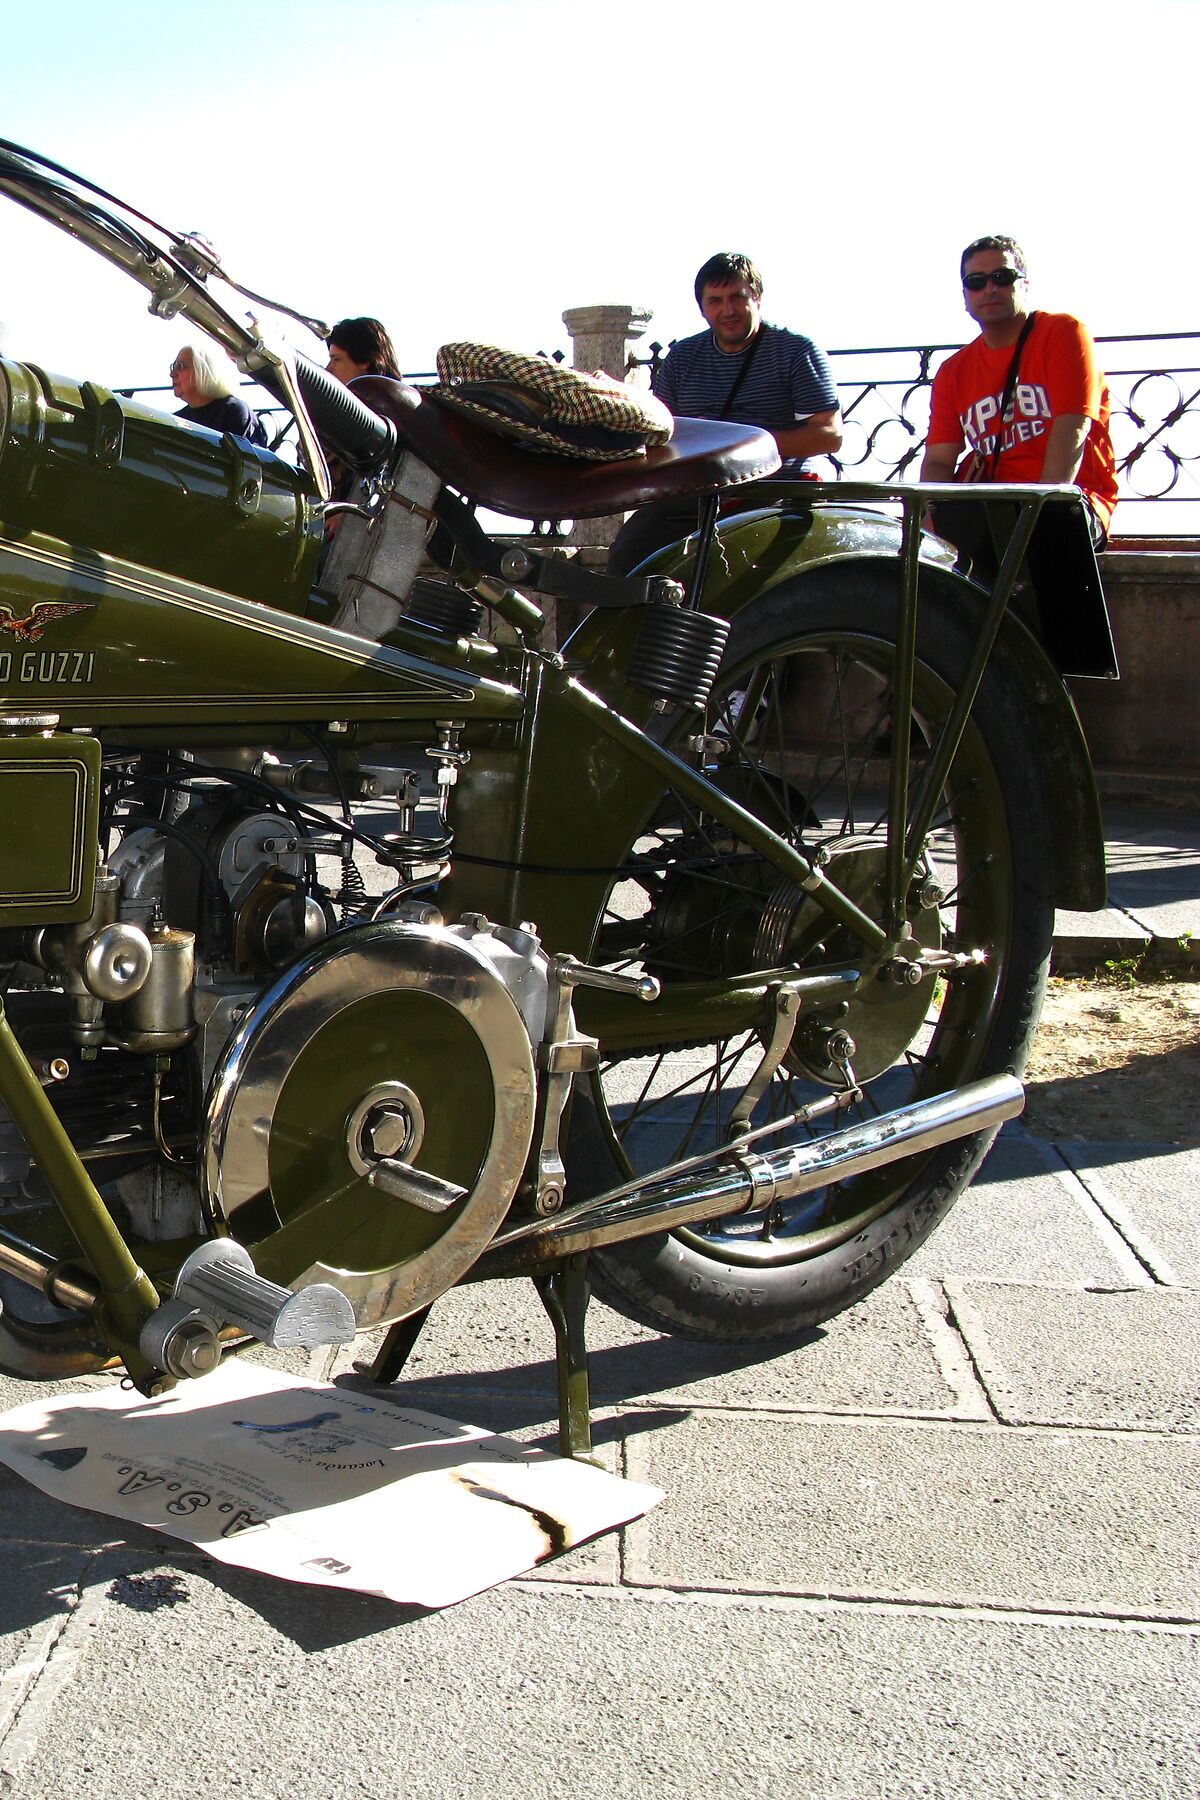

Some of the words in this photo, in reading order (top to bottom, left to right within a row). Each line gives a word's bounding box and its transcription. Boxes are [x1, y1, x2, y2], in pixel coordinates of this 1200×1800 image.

[19, 652, 95, 683] GUZZI
[316, 1458, 387, 1473] Locanda
[117, 1465, 271, 1539] A.S.A.
